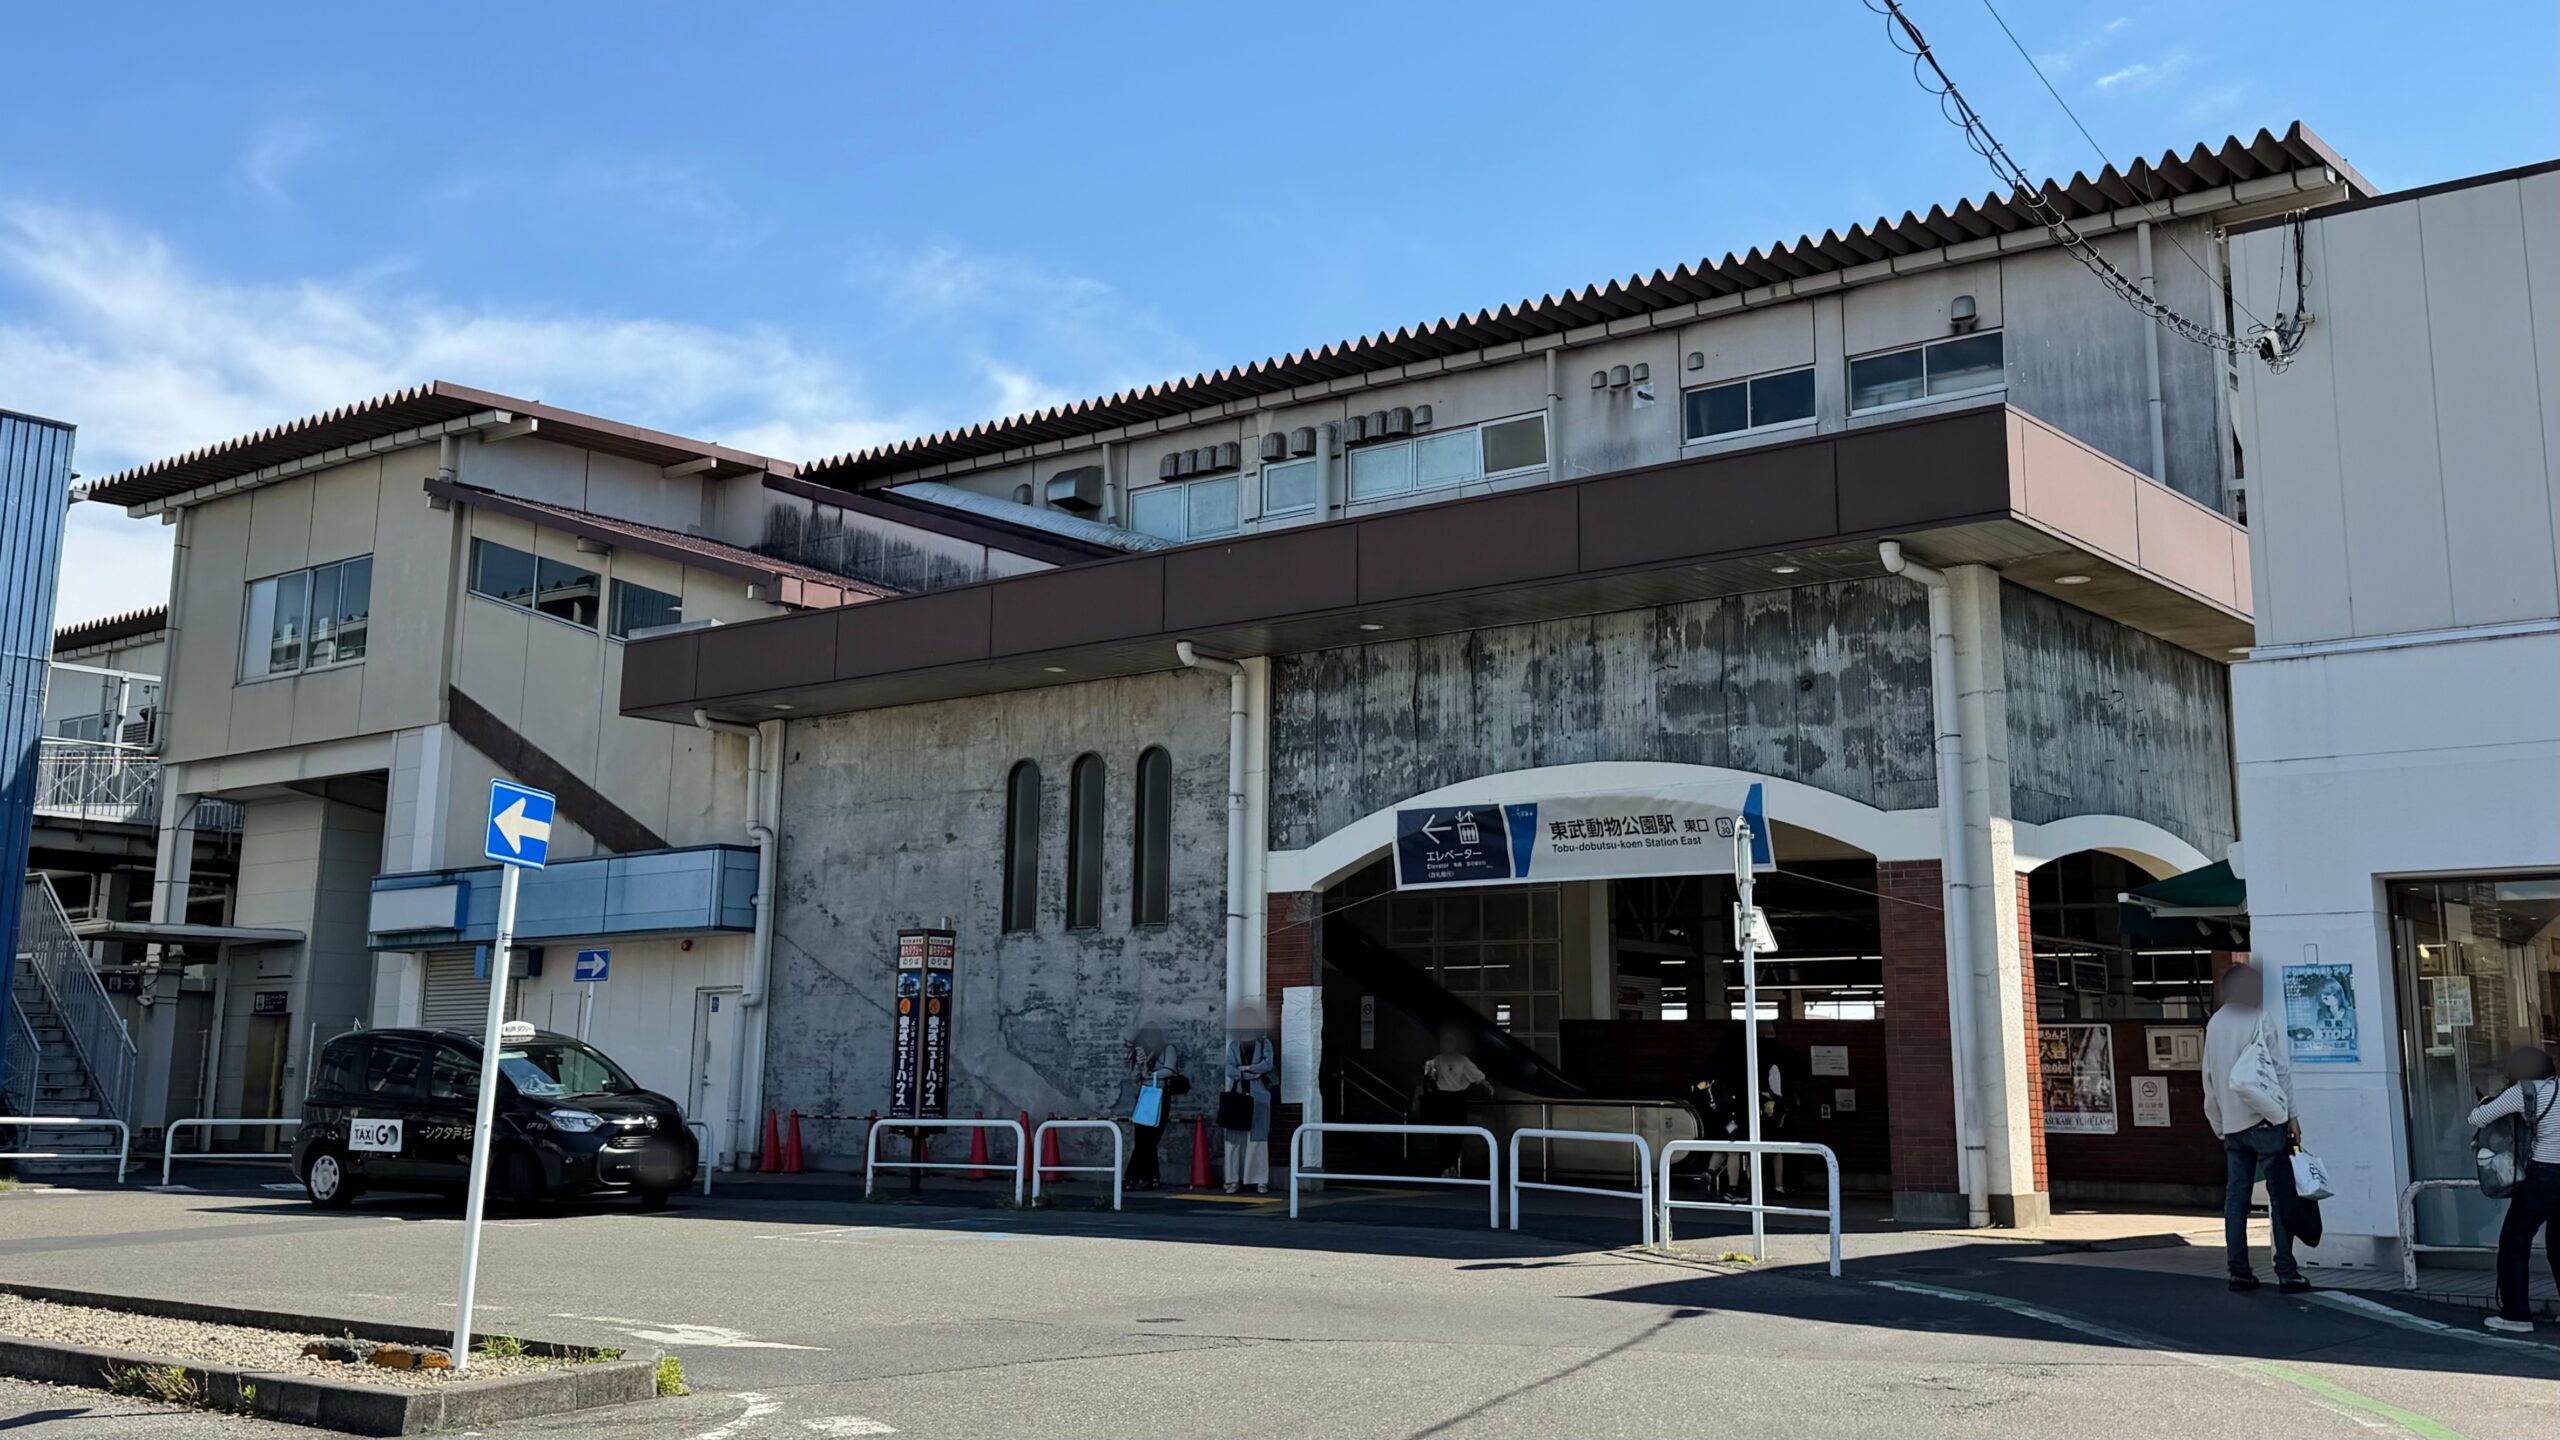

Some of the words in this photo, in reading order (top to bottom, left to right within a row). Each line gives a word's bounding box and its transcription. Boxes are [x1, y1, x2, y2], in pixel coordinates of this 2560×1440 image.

[1549, 814, 1677, 841] 東武動物公園駅
[1683, 819, 1709, 833] 東口
[1552, 840, 1643, 853] Tobu-dobutsu-koen
[1645, 837, 1679, 848] Station
[1681, 836, 1702, 846] East
[1426, 849, 1482, 861] エレベーター
[354, 1128, 374, 1141] TAXI
[376, 1124, 398, 1146] GO
